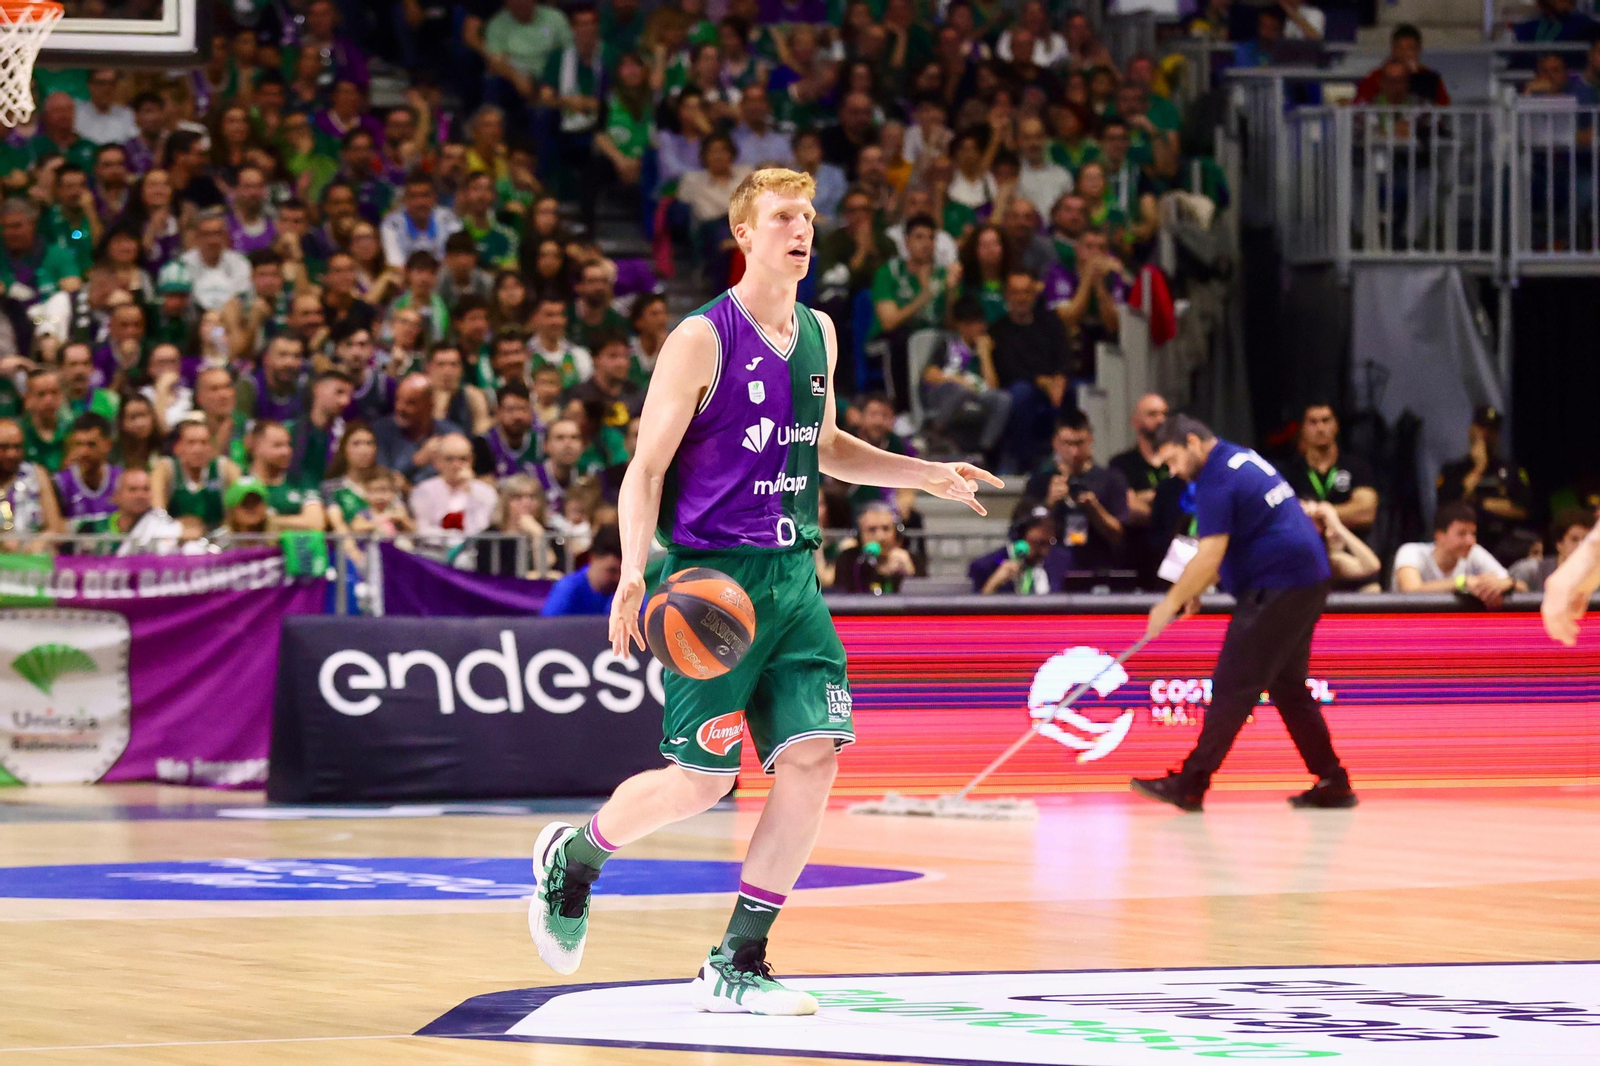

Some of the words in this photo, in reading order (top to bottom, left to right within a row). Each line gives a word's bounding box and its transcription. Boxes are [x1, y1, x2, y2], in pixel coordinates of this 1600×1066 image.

[777, 422, 819, 446] Unicaj
[776, 517, 796, 547] 0
[674, 630, 709, 674] endesa
[1149, 678, 1214, 704] COST
[1007, 992, 1499, 1042] Unicaja
[1162, 979, 1600, 1027] Fundac
